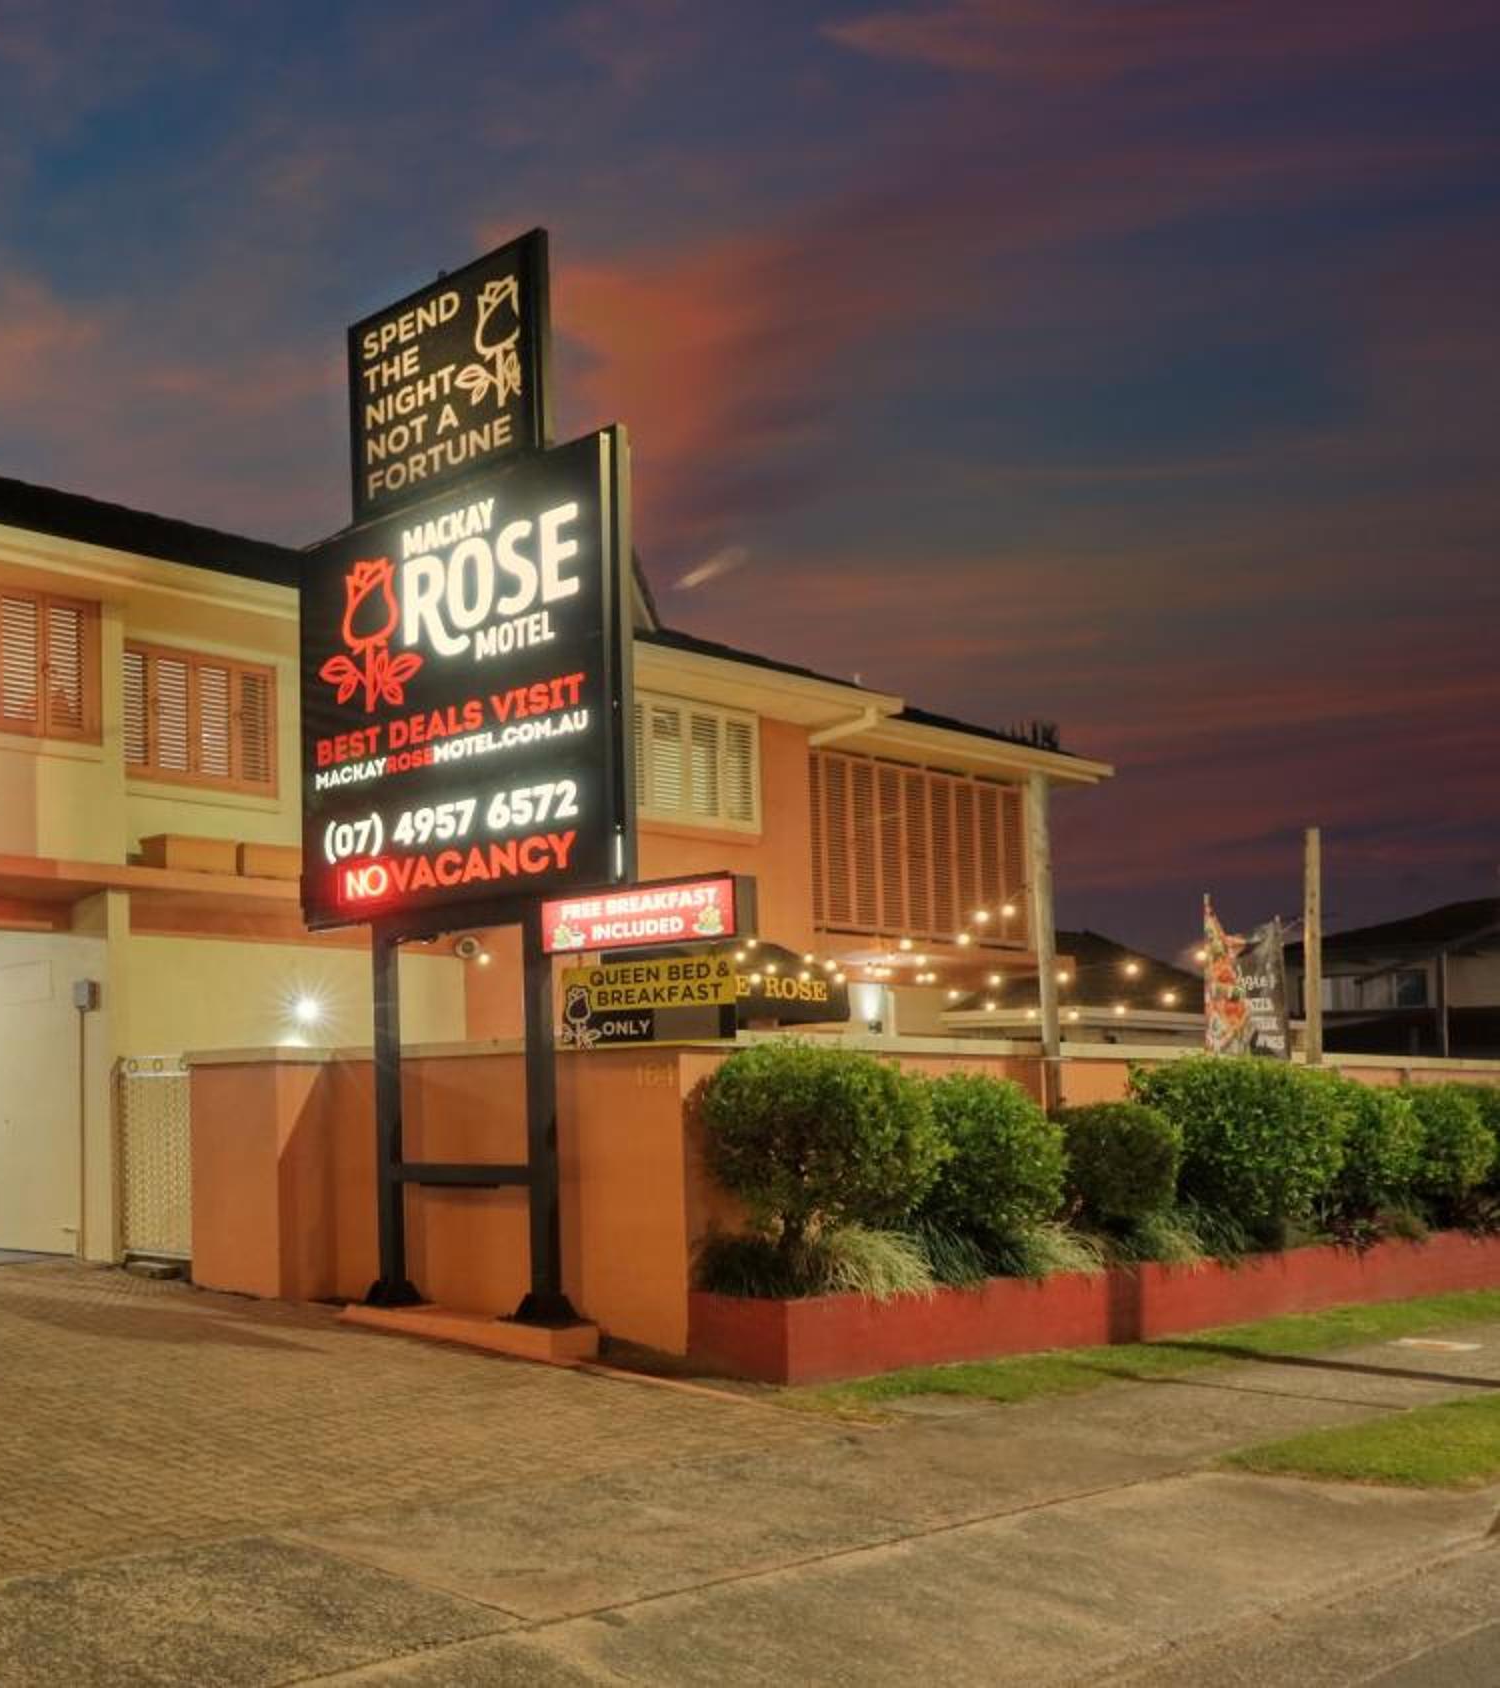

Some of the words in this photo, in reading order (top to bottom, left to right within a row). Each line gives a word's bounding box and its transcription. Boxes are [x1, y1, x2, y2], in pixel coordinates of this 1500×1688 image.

[363, 291, 460, 359] SPEND
[364, 346, 420, 394] THE
[365, 364, 456, 429] NIGHT
[367, 414, 428, 464] NOT
[436, 404, 459, 435] A
[367, 415, 513, 500] FORTUNE
[402, 498, 495, 558] MACKAY
[402, 502, 580, 657] ROSE
[475, 611, 556, 661] MOTEL
[315, 726, 381, 768] BEST
[388, 700, 484, 750] DEALS
[491, 672, 586, 723] VISIT
[315, 709, 589, 790] MACKAYROSEMOTEL.COM.AU
[324, 812, 384, 864] (07)
[393, 799, 477, 845] 4957
[487, 779, 579, 830] 6572
[345, 864, 388, 899] NO
[387, 830, 577, 892] VACANCY
[560, 901, 602, 921] FREE
[606, 887, 718, 915] BREAKFAST
[591, 916, 684, 941] INCLUDED
[589, 967, 660, 987] QUEEN
[668, 962, 711, 981] BED
[716, 961, 730, 977] &
[597, 983, 723, 1006] BREAKFAST
[764, 976, 827, 1001] ROSE
[603, 1020, 650, 1036] ONLY
